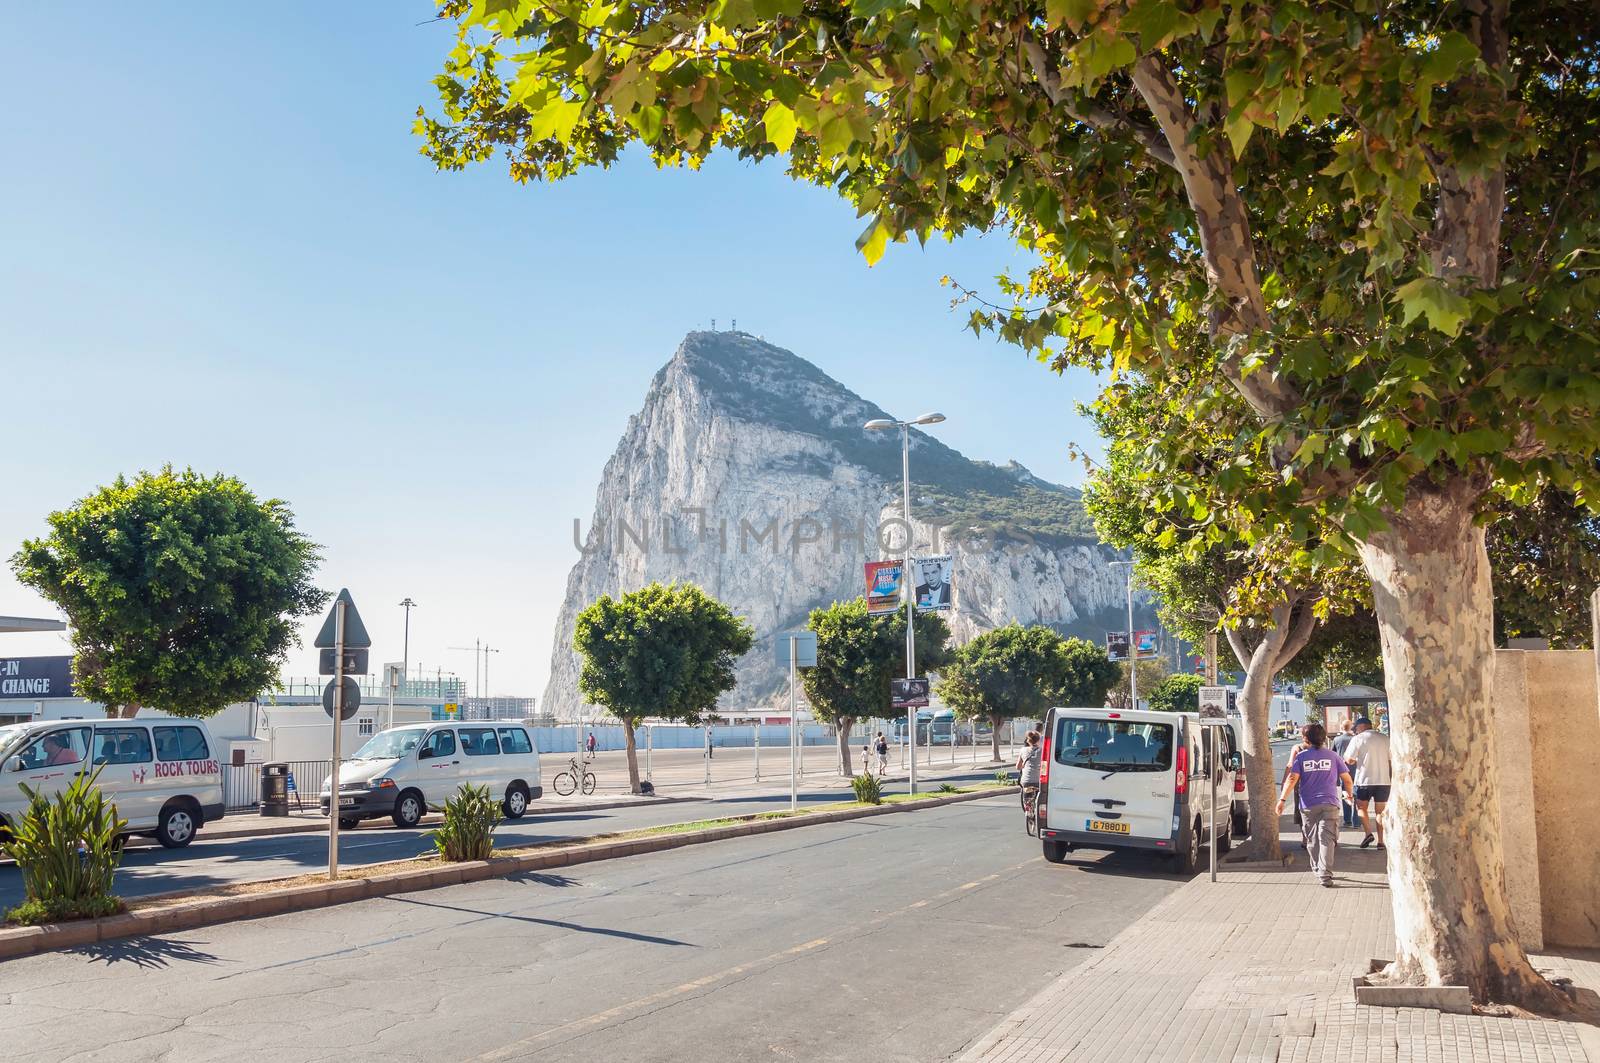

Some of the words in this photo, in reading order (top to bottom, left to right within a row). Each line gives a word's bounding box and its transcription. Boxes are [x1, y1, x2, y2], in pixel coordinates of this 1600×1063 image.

[2, 678, 50, 694] CHANGE
[155, 762, 184, 778] ROCK
[186, 759, 219, 775] TOURS
[1093, 821, 1099, 829] G
